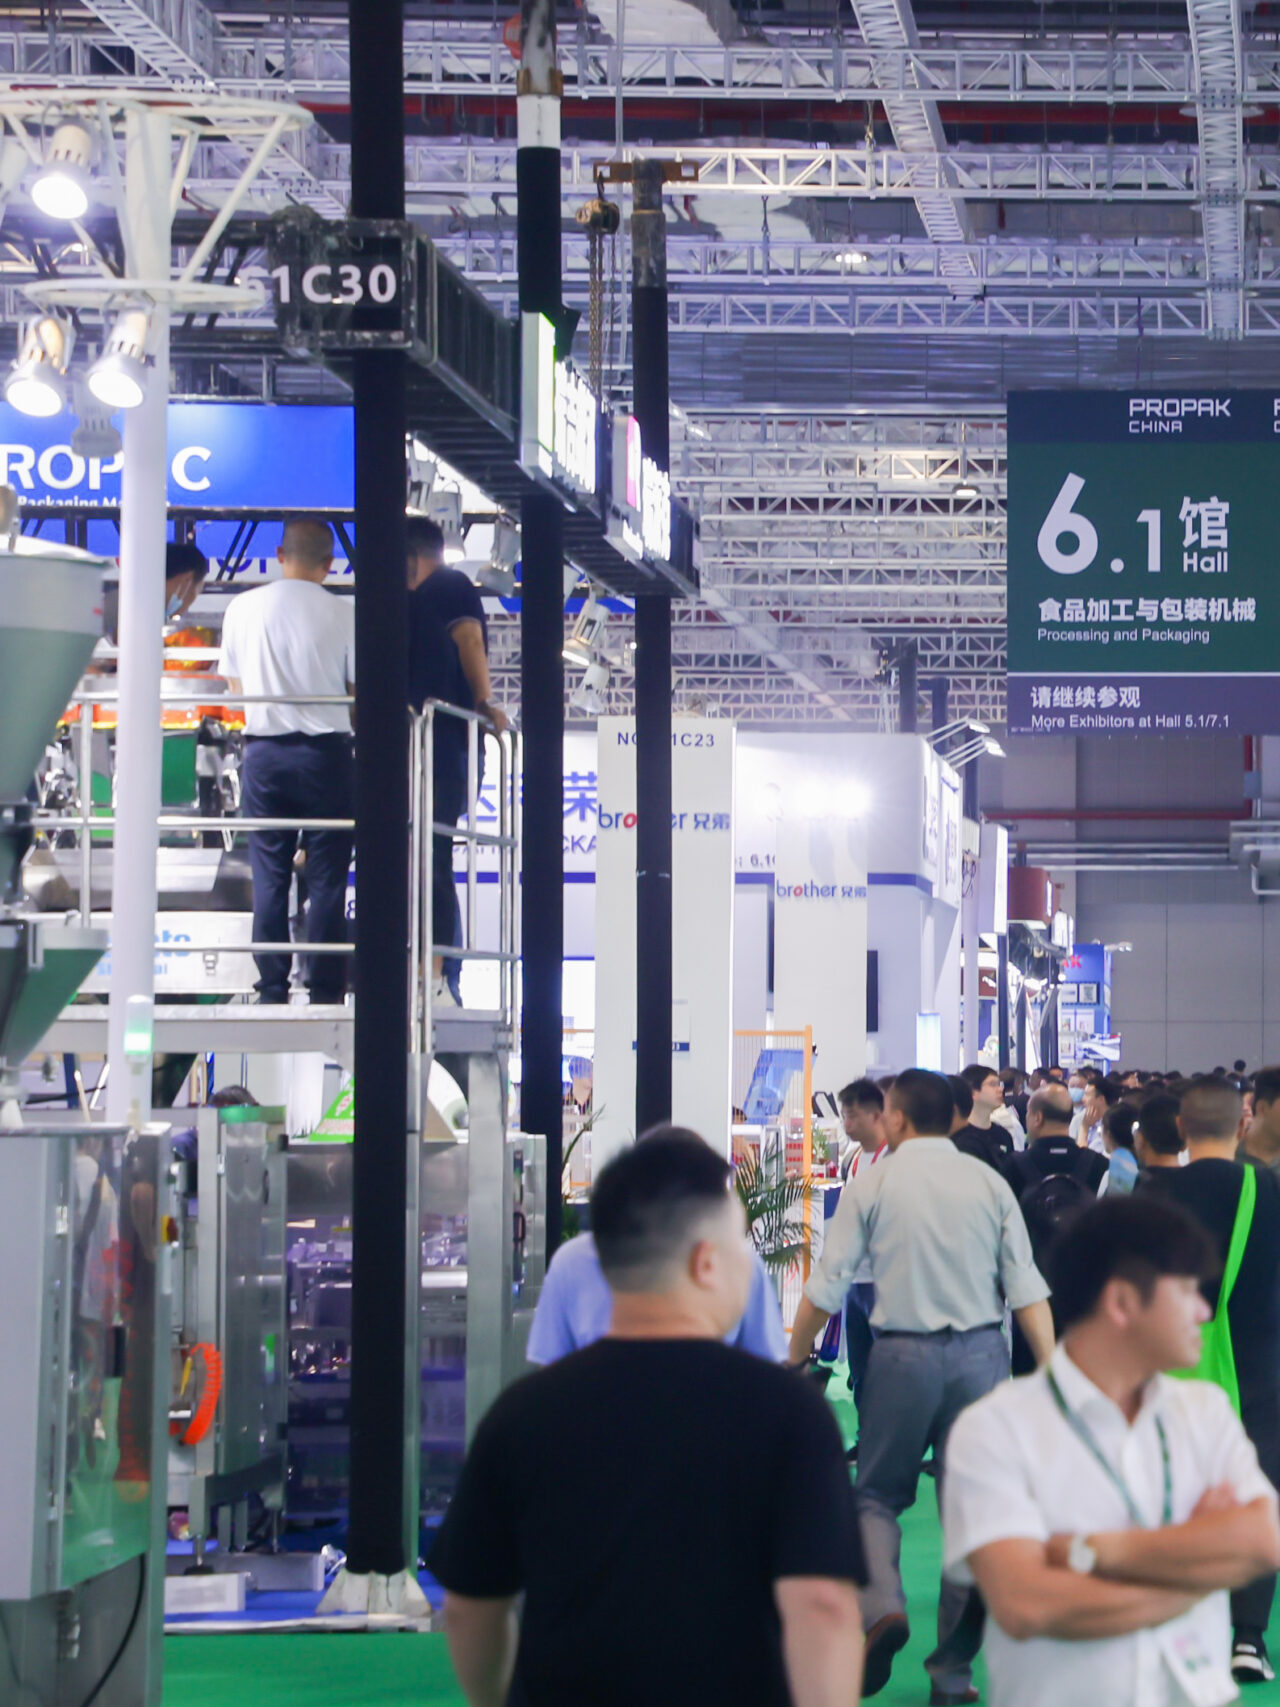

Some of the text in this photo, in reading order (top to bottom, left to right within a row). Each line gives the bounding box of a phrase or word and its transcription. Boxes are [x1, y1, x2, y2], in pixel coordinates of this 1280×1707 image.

[1129, 398, 1231, 418] PROPAK
[1129, 420, 1183, 434] CHINA
[1183, 551, 1229, 574] Hall
[1038, 597, 1257, 623] 食品加工与包装机械
[1037, 628, 1210, 644] Processing and Packaging
[1031, 686, 1141, 709] 请继续参观
[1031, 714, 1230, 728] More Exhibitors at Hall 5.1/7.1
[776, 879, 837, 898] brother
